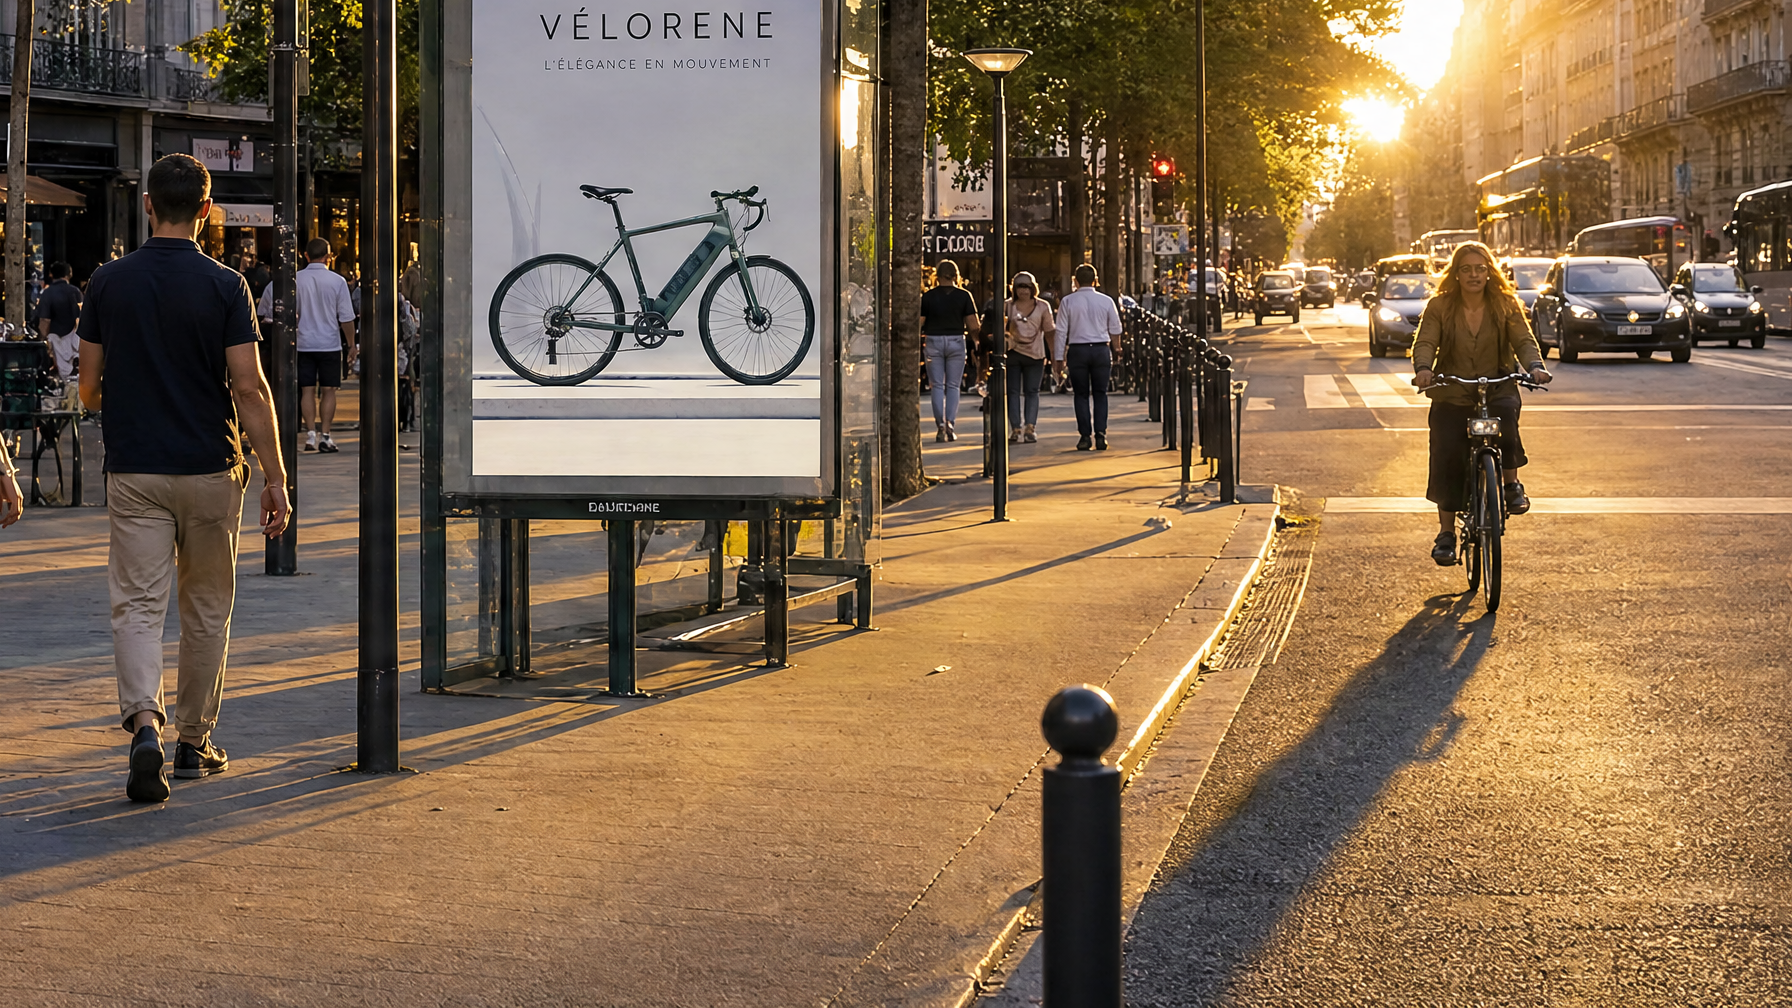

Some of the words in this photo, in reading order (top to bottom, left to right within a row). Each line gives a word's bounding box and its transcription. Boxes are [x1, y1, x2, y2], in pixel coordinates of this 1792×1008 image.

[539, 7, 773, 40] VÉLORENE
[544, 57, 637, 71] L'ÉLÉGANCE
[645, 58, 664, 69] EN
[673, 58, 771, 70] MOUVEMENT
